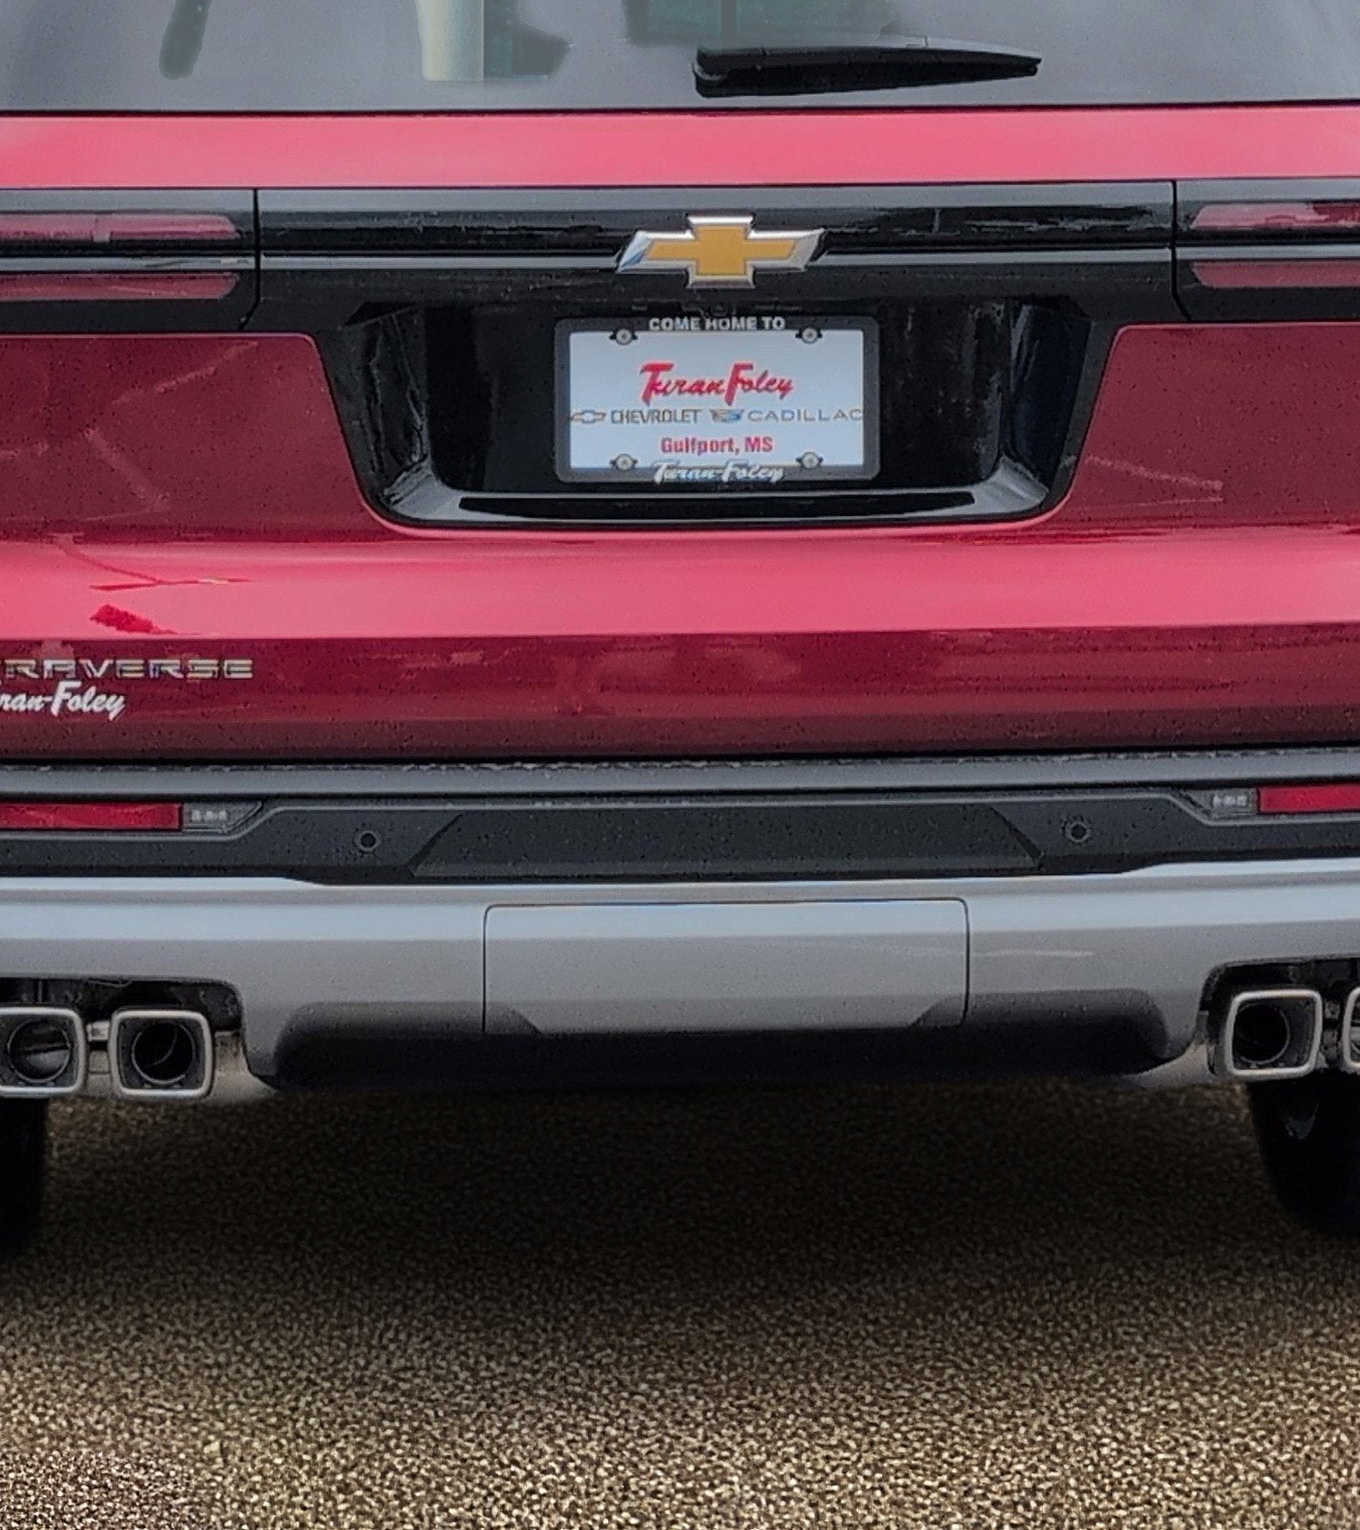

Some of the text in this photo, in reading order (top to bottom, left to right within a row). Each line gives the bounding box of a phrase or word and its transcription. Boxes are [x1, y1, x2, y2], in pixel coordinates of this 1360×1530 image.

[649, 317, 786, 331] COME HOME TO
[610, 408, 863, 424] CHEVROLET CADILLAC
[660, 436, 774, 456] Gulfport, MS
